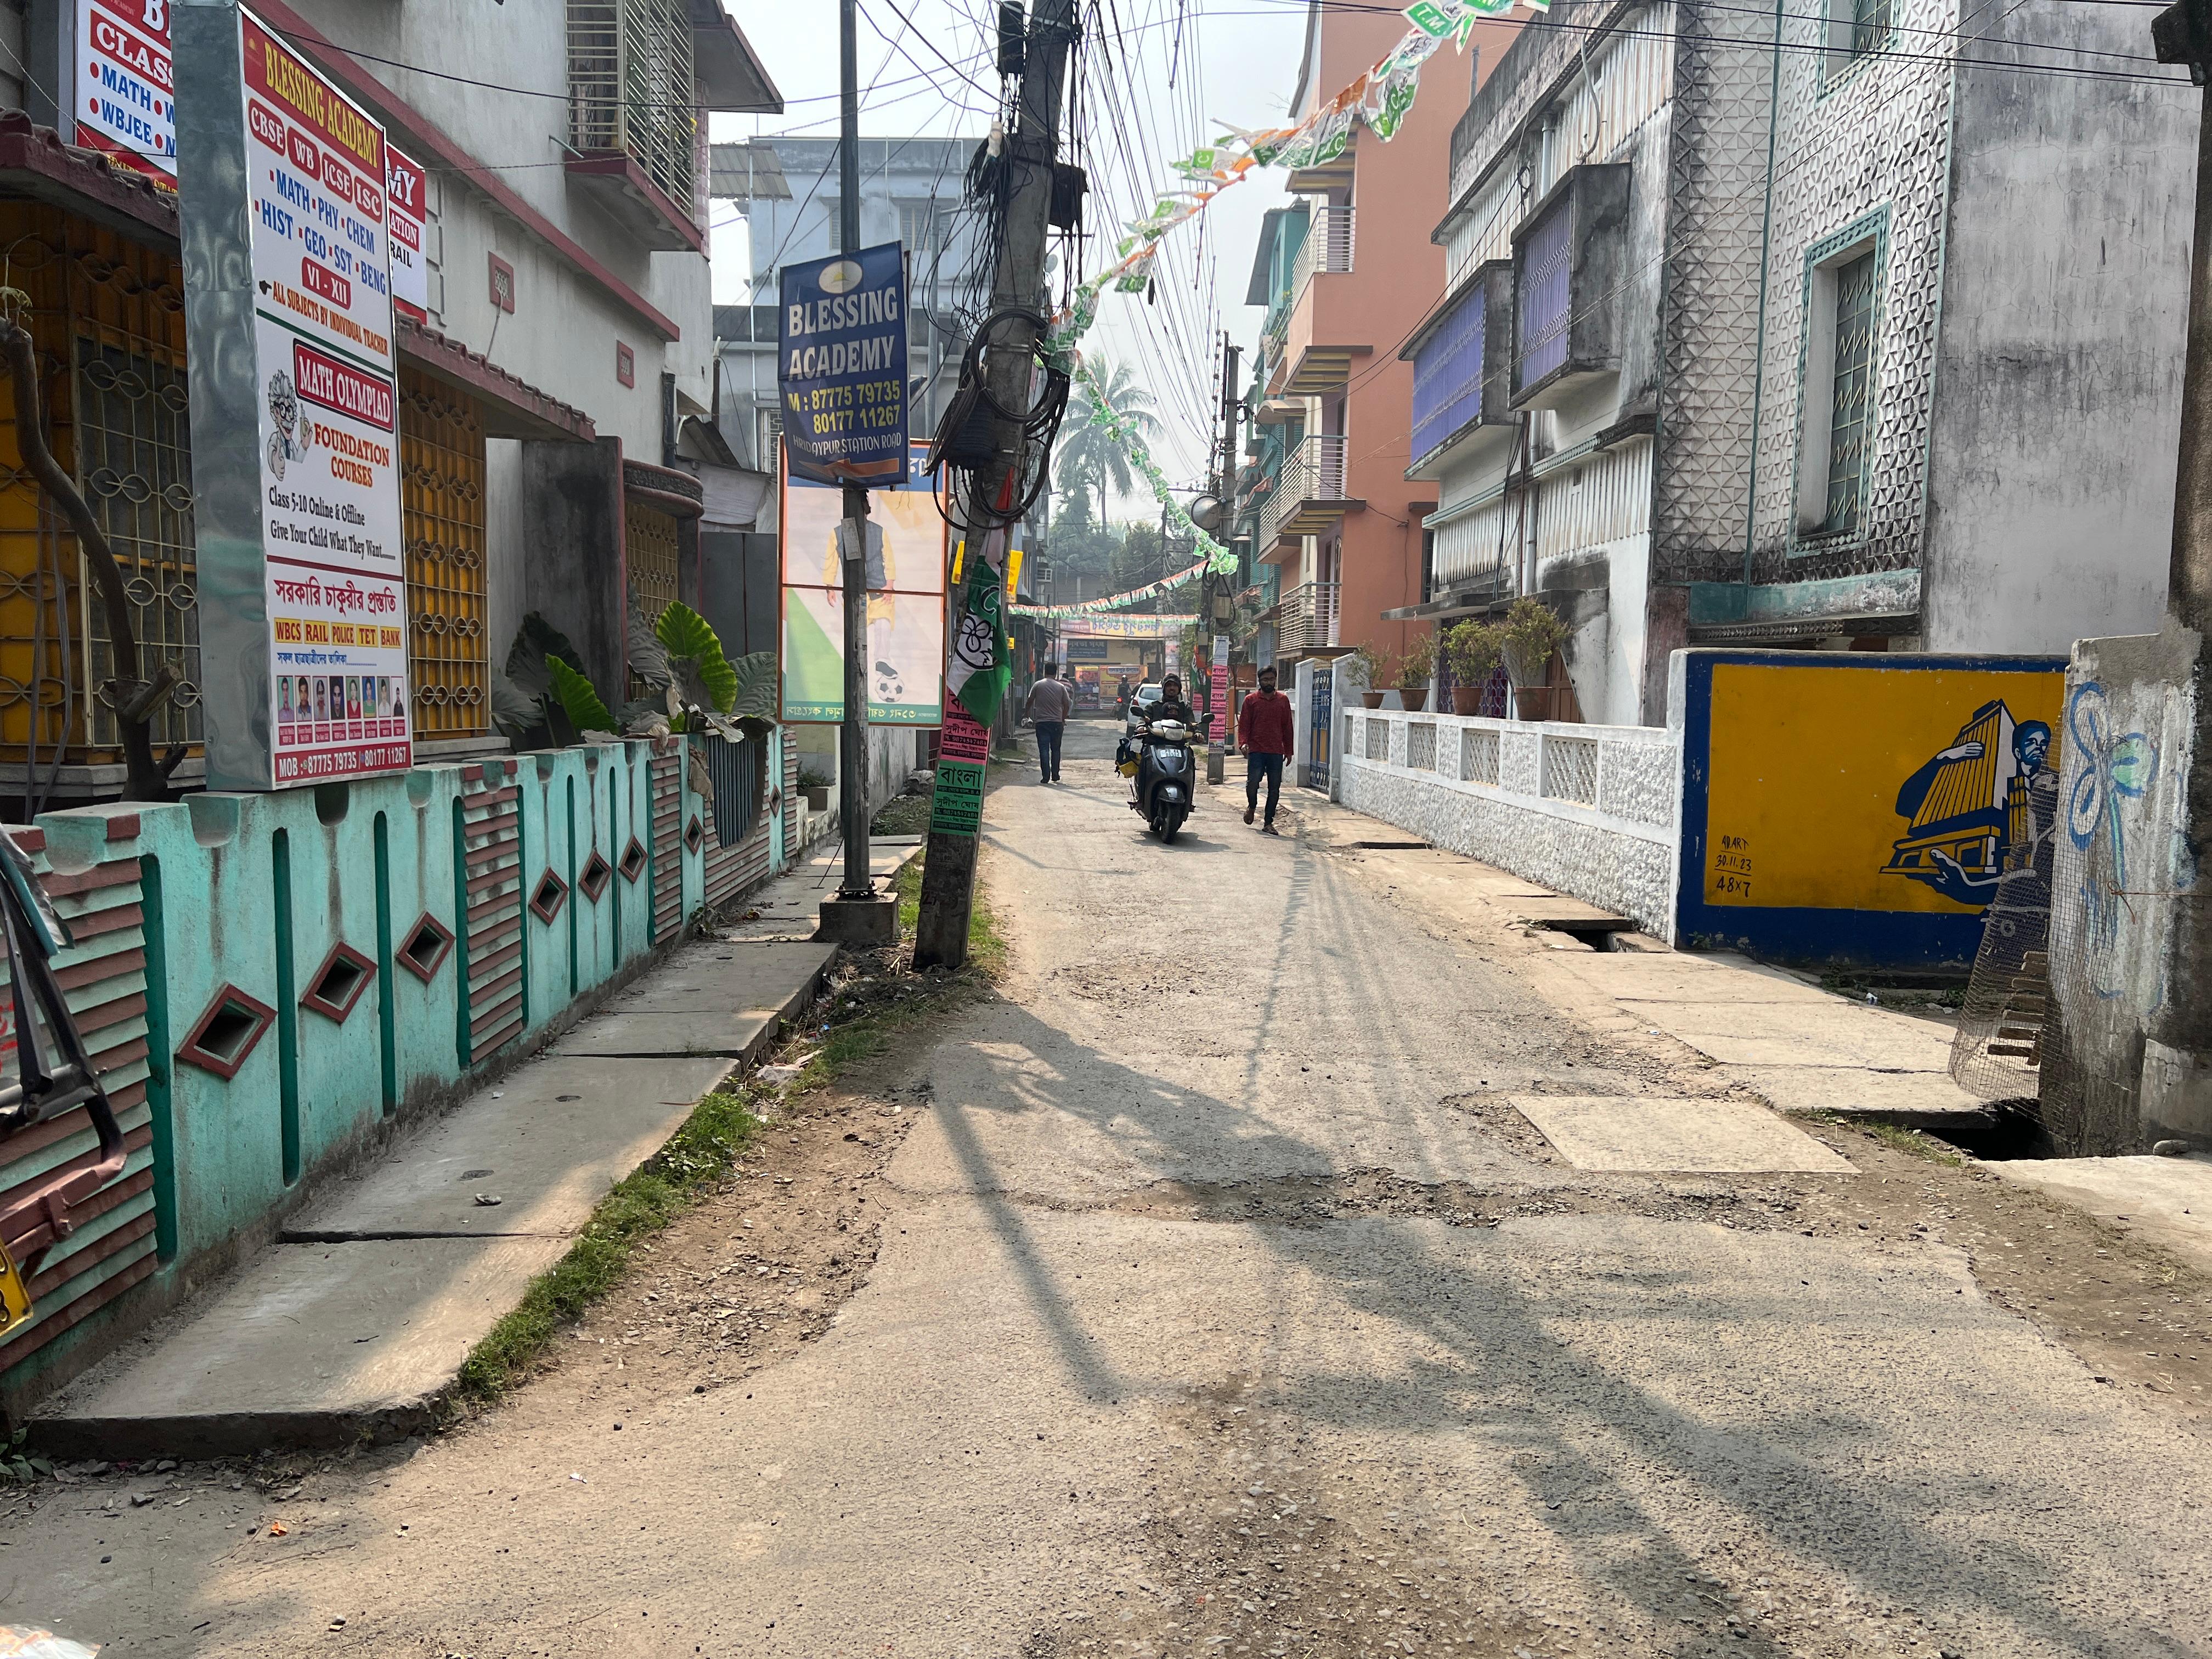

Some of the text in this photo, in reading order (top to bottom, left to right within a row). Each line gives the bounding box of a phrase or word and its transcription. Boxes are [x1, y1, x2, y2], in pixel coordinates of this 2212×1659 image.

[102, 63, 151, 111] MATH
[101, 98, 152, 145] WBJEE
[264, 42, 378, 169] BLESSING ACADEMY
[251, 107, 284, 149] CBSE
[294, 137, 314, 170] WB
[324, 159, 351, 196] ICSE
[276, 168, 375, 255] MATH PHY CHEM
[356, 183, 381, 216] ISC
[262, 198, 386, 295] HIST GEO SST BENG
[390, 212, 417, 246] ATION
[307, 263, 320, 290] VI
[331, 276, 348, 304] XII
[273, 281, 388, 357] ALL SUBJECTS BY INDIVIDUAL TEACHER
[788, 286, 898, 337] BLESSING
[789, 335, 895, 381] ACADEMY
[299, 356, 390, 424] MATH OLYMPIAD
[812, 386, 853, 410] 87775
[856, 380, 900, 404] 79735
[813, 404, 900, 434] 80177 11267
[314, 424, 390, 467] FOUNDATION
[793, 432, 901, 457] HRIDAYPUR STATION ROAD
[331, 456, 373, 488] COURSES
[269, 486, 365, 526] Class 5-10 Online & Offline
[271, 520, 289, 540] Give
[290, 523, 307, 544] Your
[309, 526, 328, 548] Child
[329, 531, 348, 552] What
[348, 534, 365, 560] They
[274, 576, 321, 607] সরকারি
[368, 586, 396, 616] প্রস্তুতি
[276, 622, 301, 641] WBCS
[305, 624, 329, 642] RAIL
[332, 625, 354, 644] POLICE
[359, 628, 376, 645] TET
[381, 630, 400, 646] BANK
[946, 724, 968, 735] সুদীপ
[279, 757, 298, 778] MOB
[308, 754, 332, 774] 87775
[334, 751, 357, 771] 79735
[365, 748, 385, 766] 80177
[387, 747, 407, 764] 11267
[939, 766, 982, 788] বাংলা
[1715, 855, 1751, 871] 30.11.23
